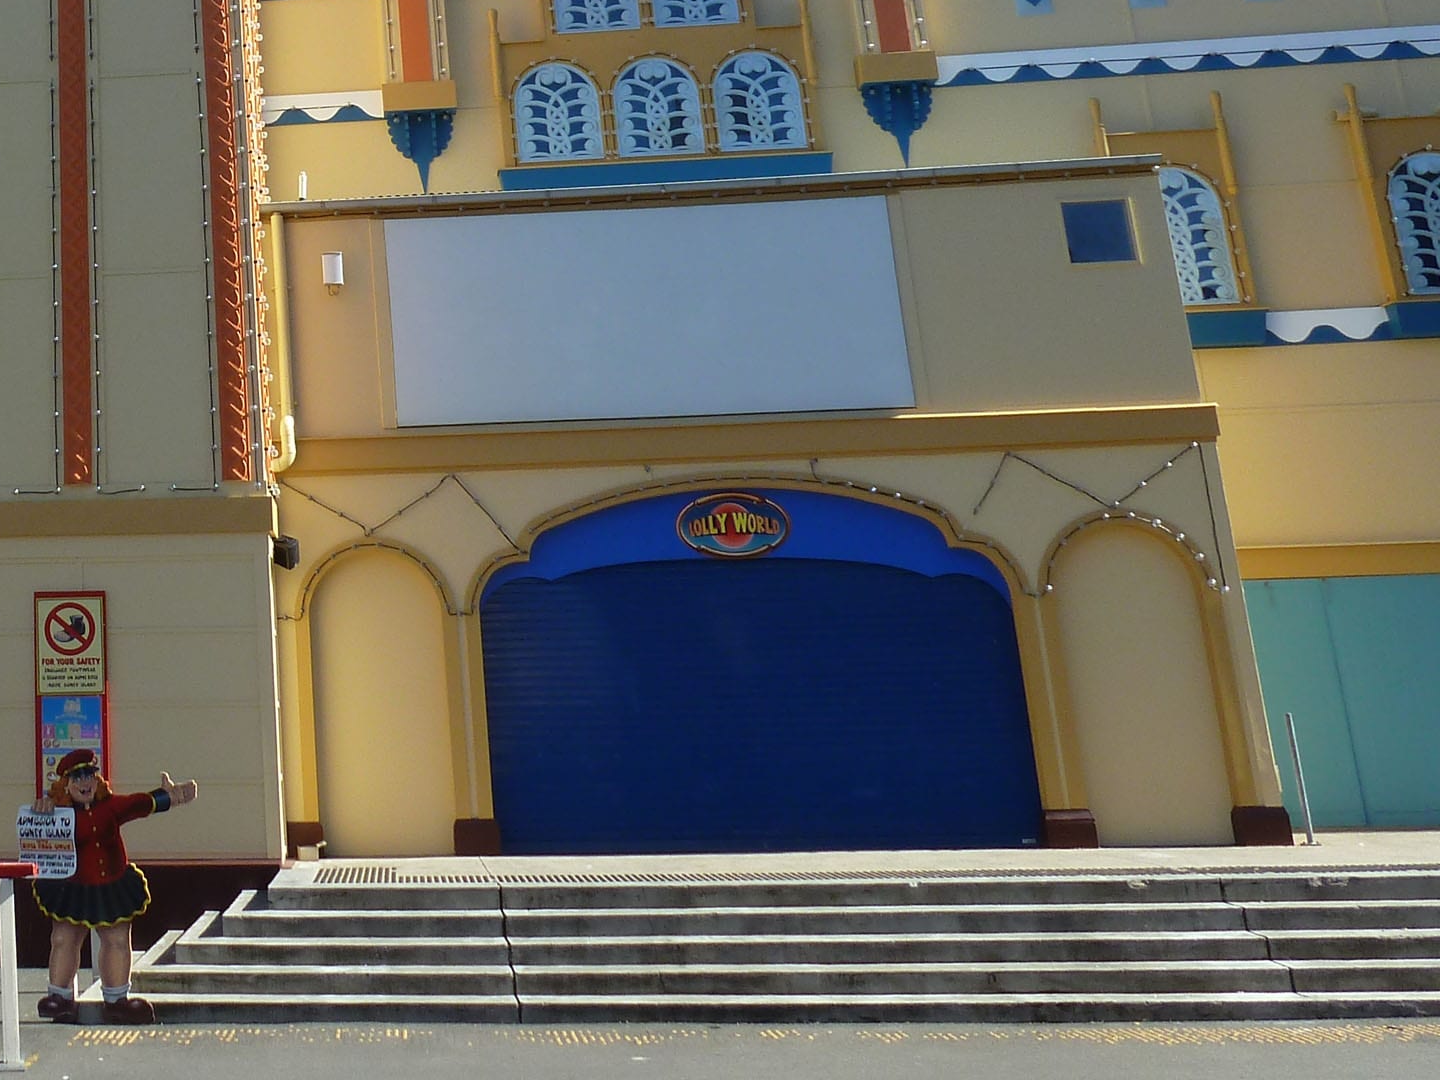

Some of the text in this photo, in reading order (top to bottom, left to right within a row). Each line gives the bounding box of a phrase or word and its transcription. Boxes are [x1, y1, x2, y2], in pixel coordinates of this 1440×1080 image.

[732, 511, 780, 535] WORLD
[17, 816, 71, 826] ADMISSION TO
[19, 828, 72, 838] CONEY ISLAND
